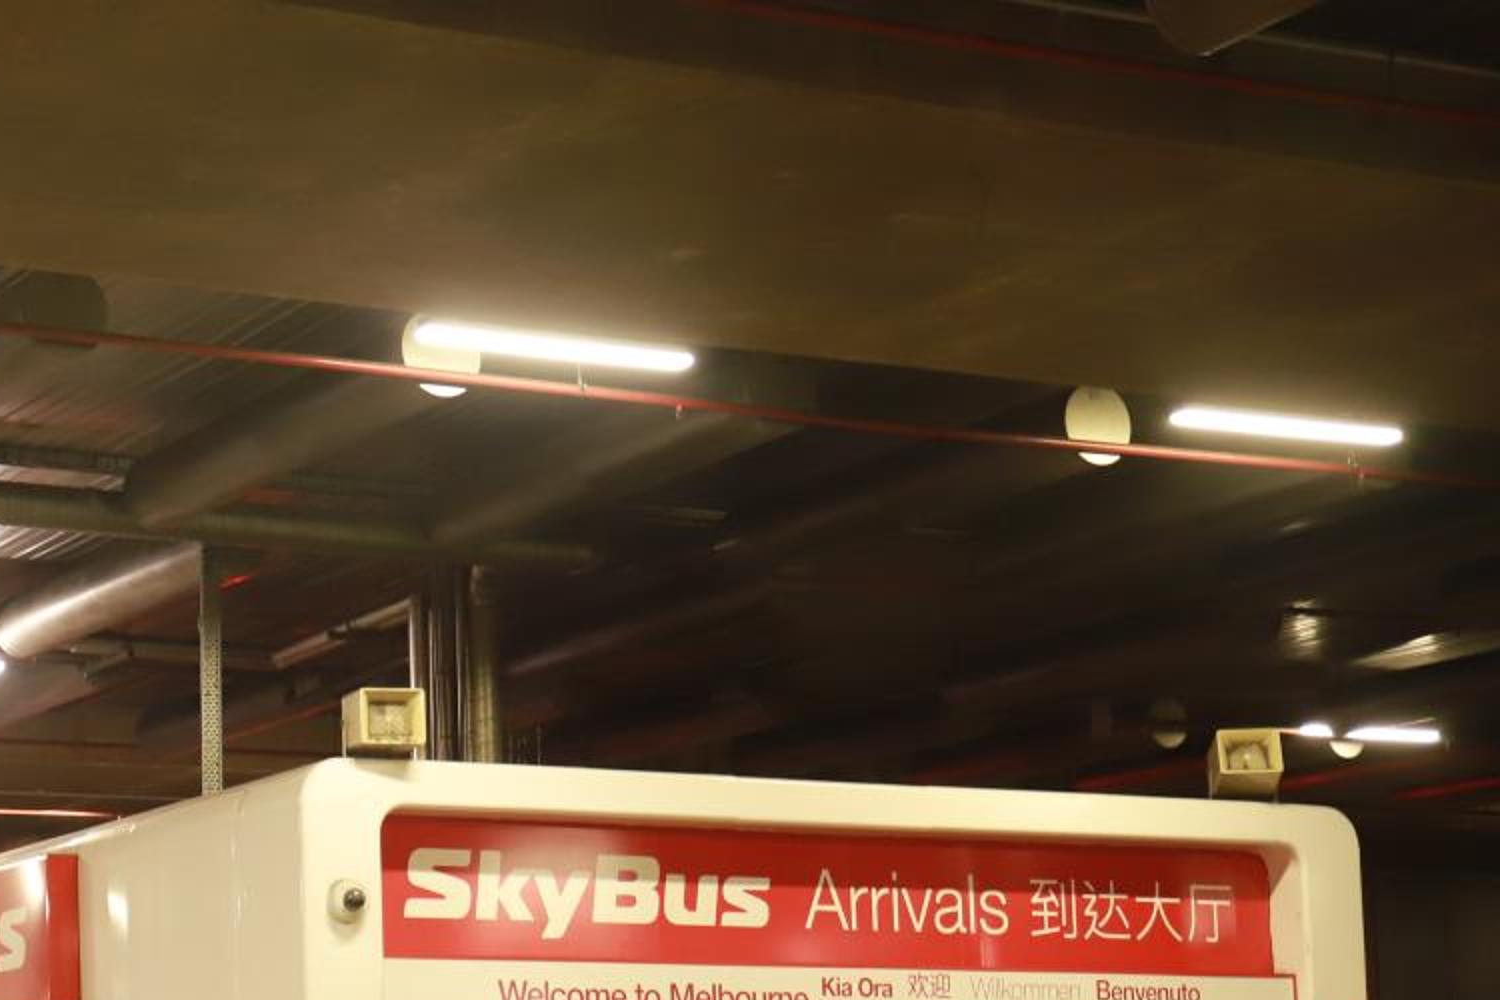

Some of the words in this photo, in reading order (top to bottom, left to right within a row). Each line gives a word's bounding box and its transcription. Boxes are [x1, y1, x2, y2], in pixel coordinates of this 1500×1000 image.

[404, 847, 770, 939] SkyBus
[805, 868, 1010, 936] Arrivals
[1029, 877, 1233, 944] 到达大厅
[821, 977, 852, 997] Kia
[858, 977, 893, 998] Ora
[907, 973, 951, 999] 欢迎
